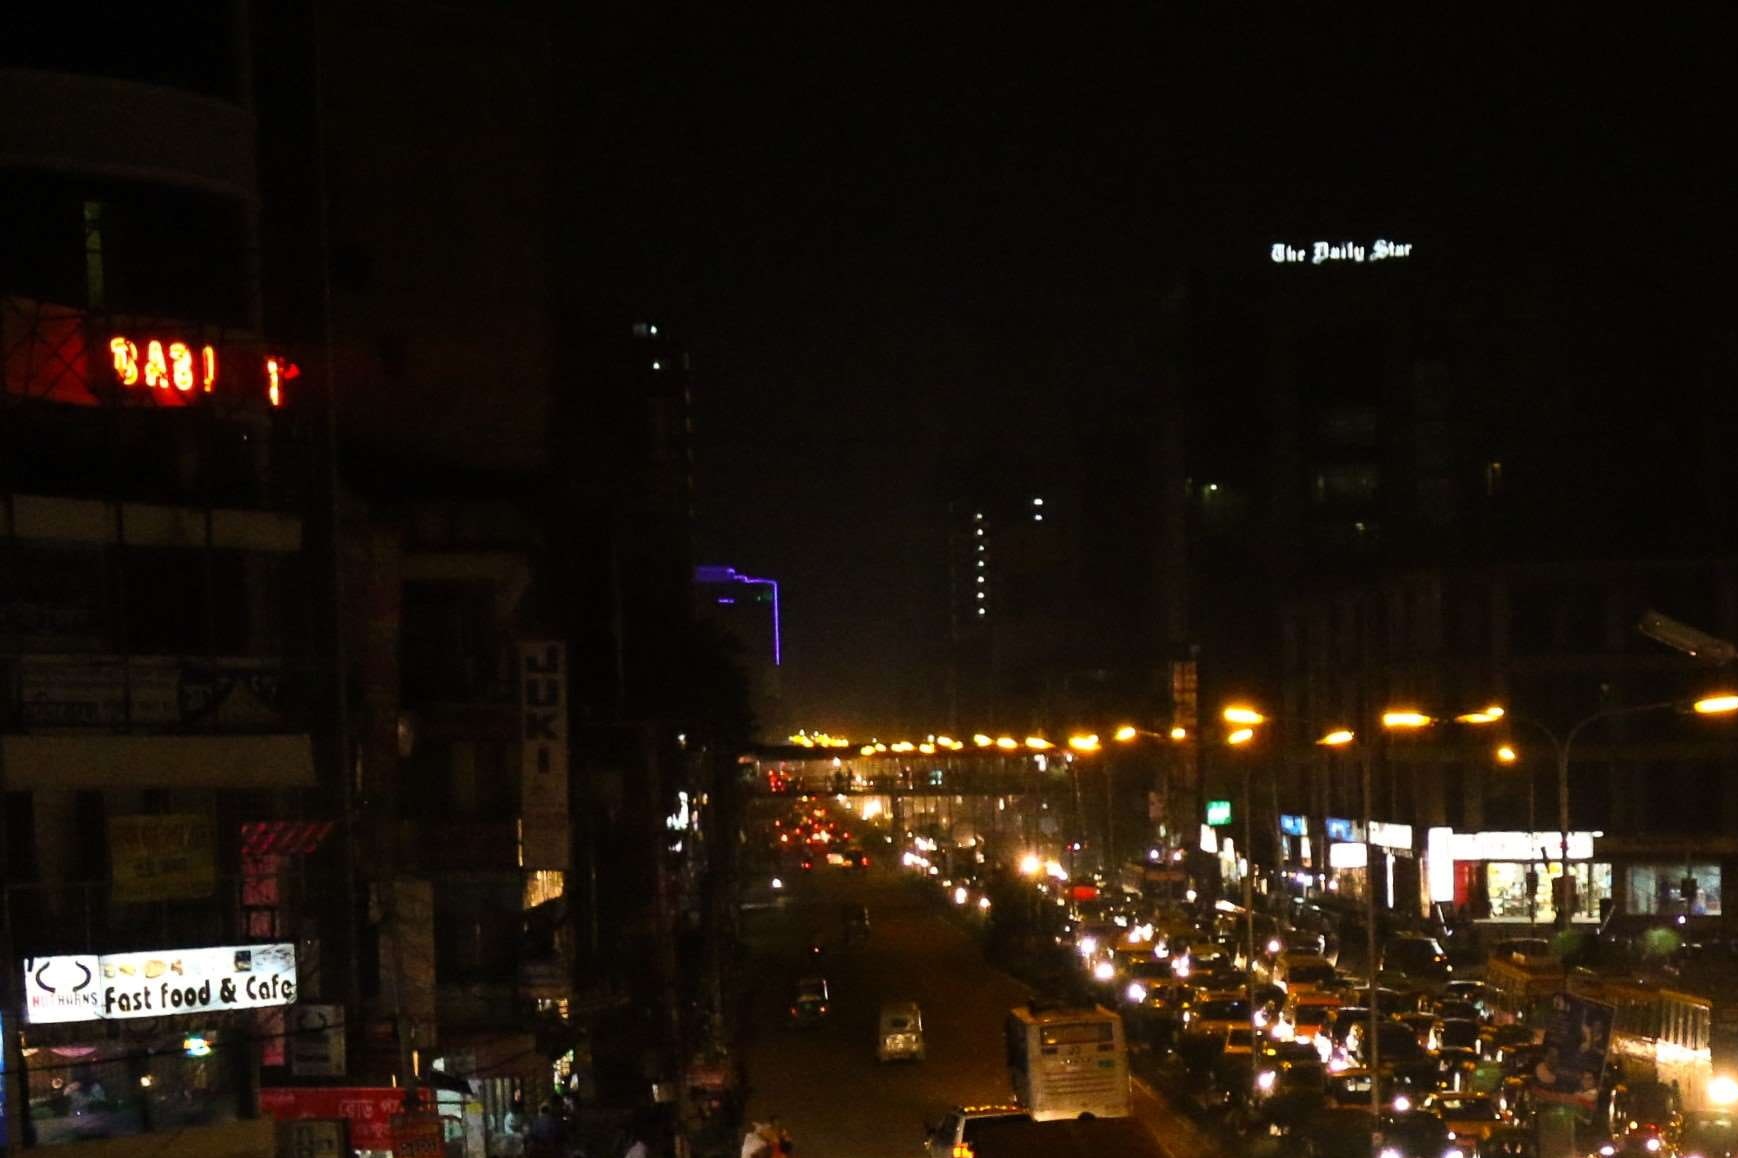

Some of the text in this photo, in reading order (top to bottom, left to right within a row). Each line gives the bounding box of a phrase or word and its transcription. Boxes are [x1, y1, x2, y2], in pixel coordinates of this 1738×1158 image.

[1271, 239, 1413, 264] The Daily Star
[160, 978, 211, 1009] food
[219, 977, 238, 1003] &
[245, 974, 294, 1001] Cafe
